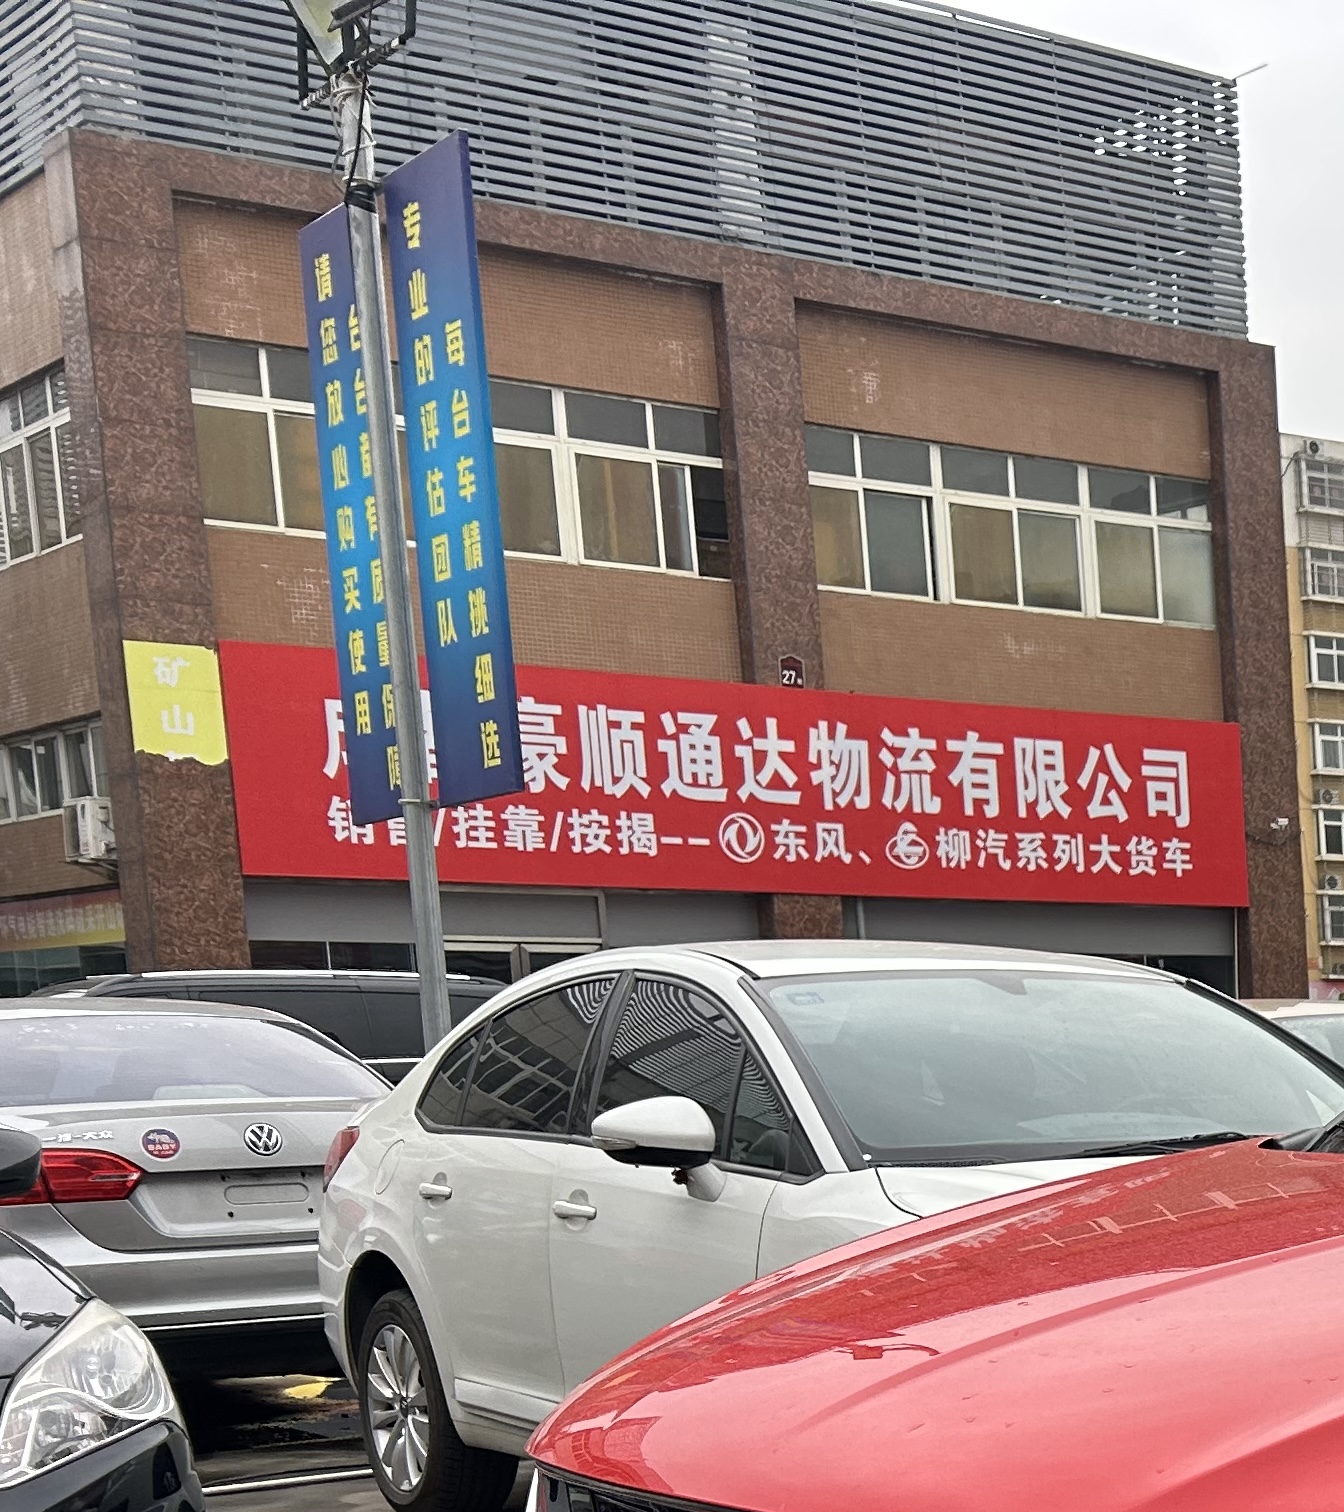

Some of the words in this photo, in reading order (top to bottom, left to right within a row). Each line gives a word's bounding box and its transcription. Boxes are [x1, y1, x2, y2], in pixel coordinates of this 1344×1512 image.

[403, 201, 458, 648] 专业的评估团队
[314, 253, 373, 737] 请您放心购买使用
[445, 319, 502, 769] 每台车精挑细选
[152, 656, 195, 761] 矿山
[323, 690, 1191, 829] 豪顺通达物流有限公司
[935, 827, 1194, 877] 柳汽系列大货车
[147, 1143, 176, 1151] BABY
